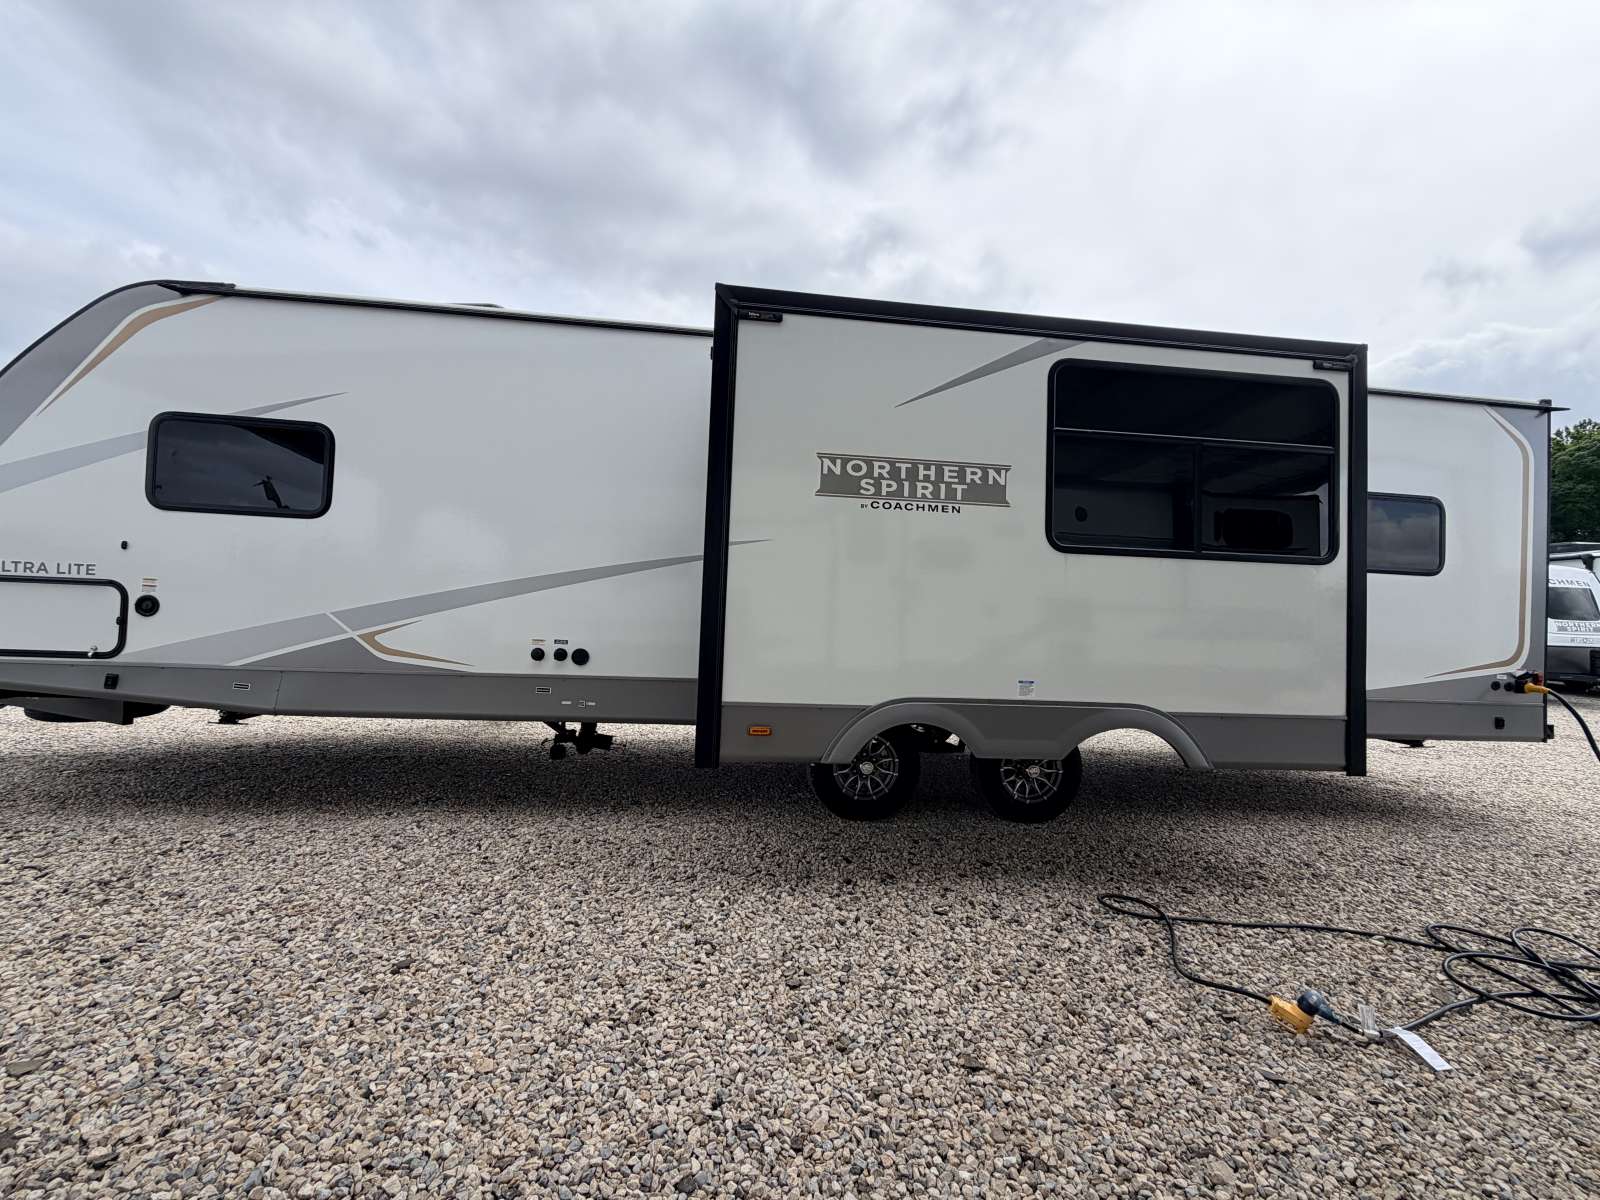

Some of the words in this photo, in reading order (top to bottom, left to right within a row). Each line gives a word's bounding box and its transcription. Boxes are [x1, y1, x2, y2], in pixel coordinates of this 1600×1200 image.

[822, 457, 1006, 486] NORTHERN
[859, 478, 968, 501] SPIRIT
[870, 500, 961, 514] COACHMEN
[56, 562, 97, 576] LITE
